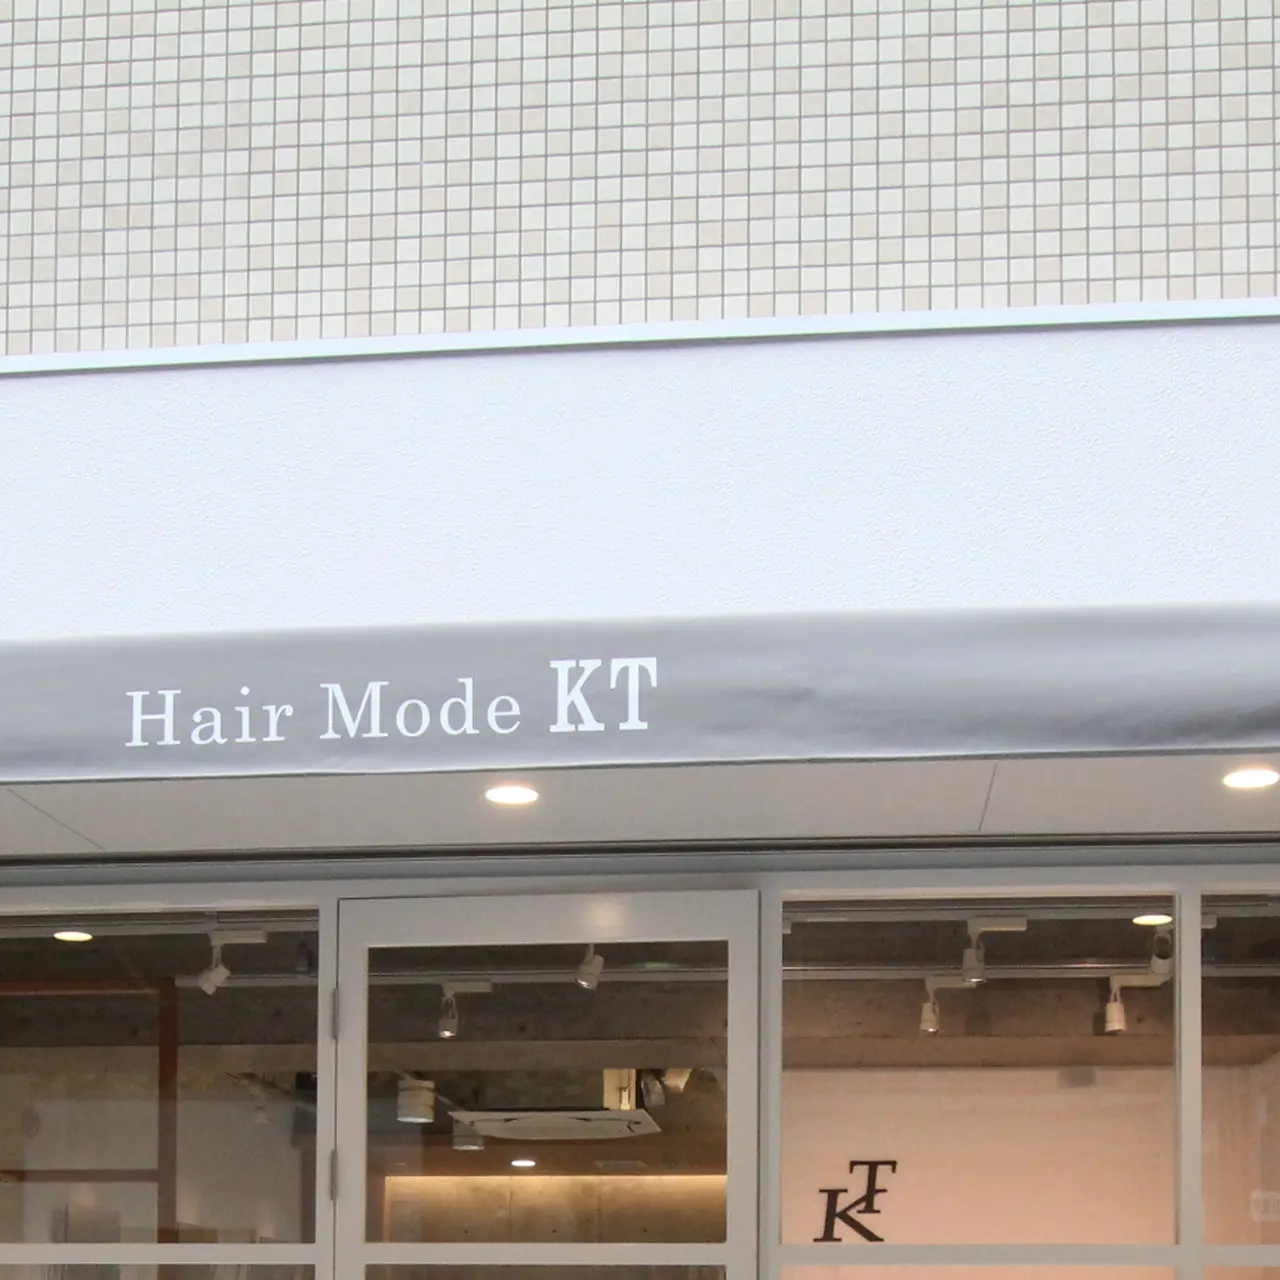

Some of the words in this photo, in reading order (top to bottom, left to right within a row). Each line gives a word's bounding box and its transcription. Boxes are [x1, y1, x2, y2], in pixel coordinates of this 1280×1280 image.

[124, 685, 294, 747] Hair
[320, 677, 521, 740] Mode
[548, 656, 658, 733] KT
[813, 1160, 898, 1242] KT
